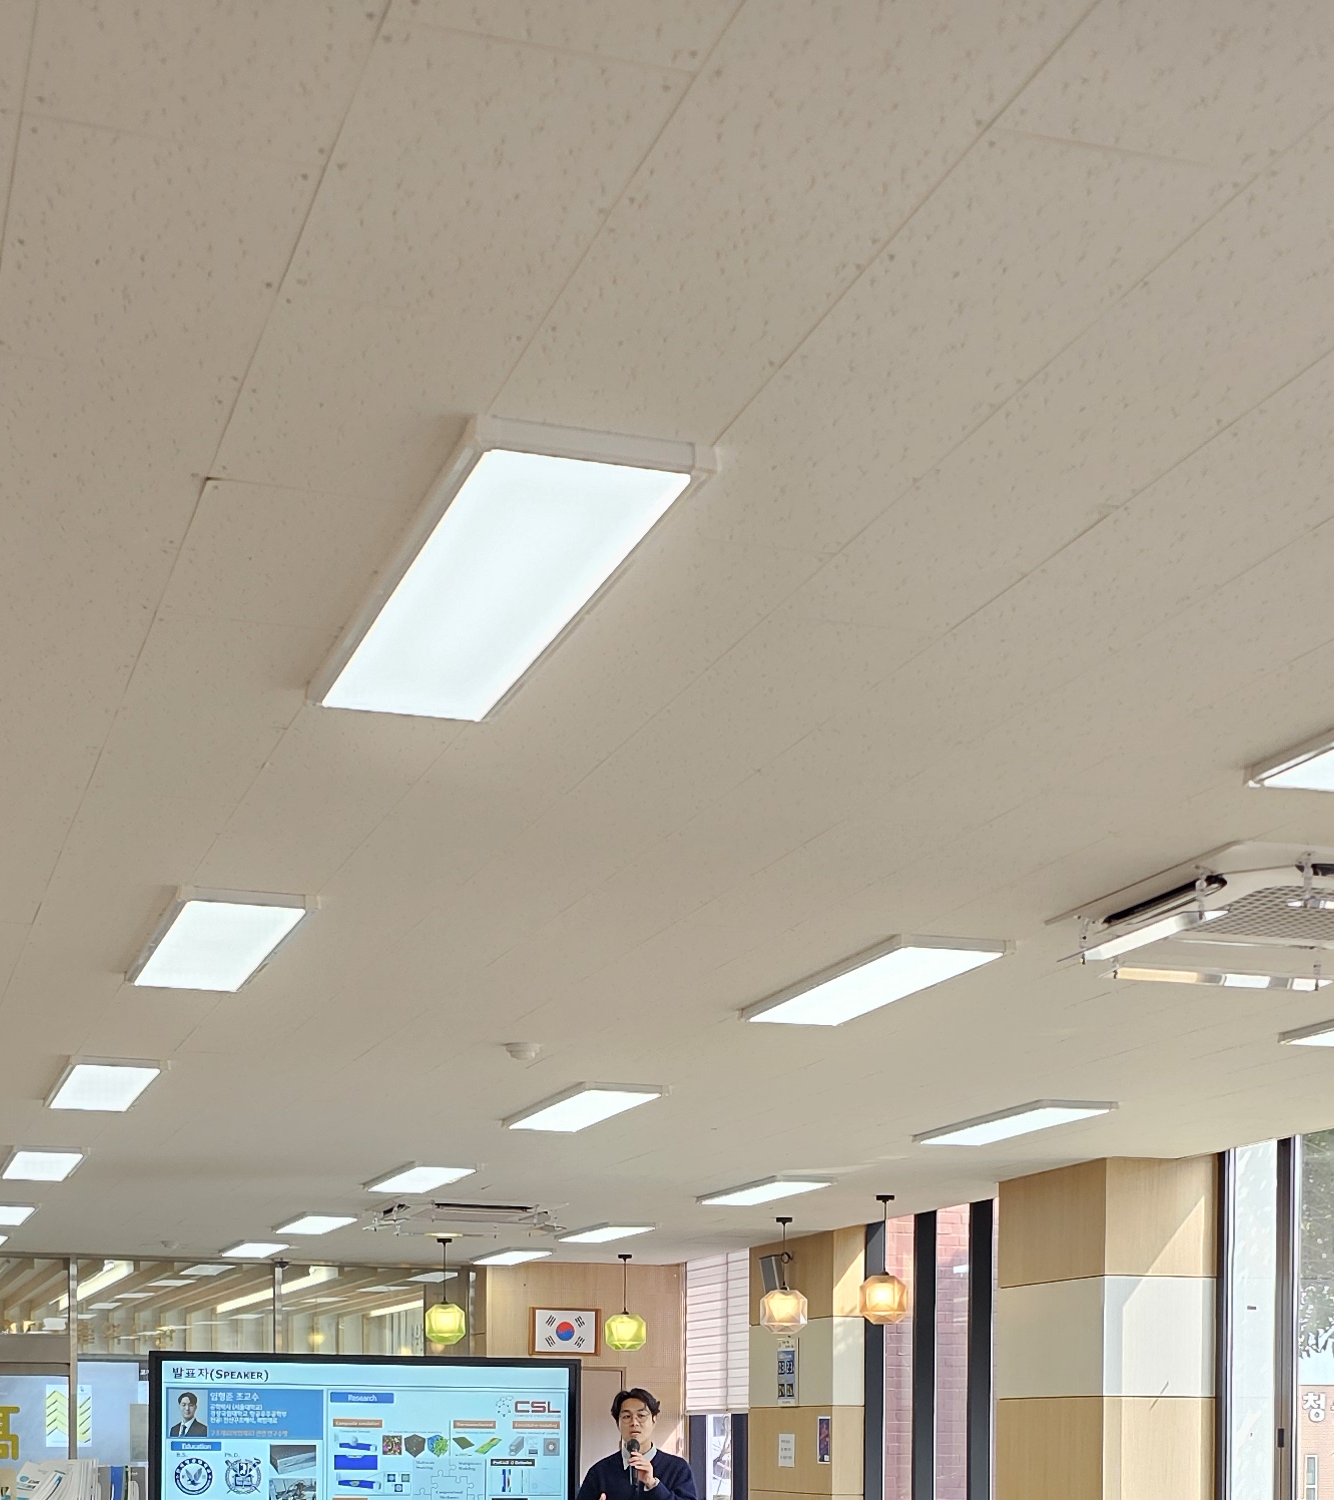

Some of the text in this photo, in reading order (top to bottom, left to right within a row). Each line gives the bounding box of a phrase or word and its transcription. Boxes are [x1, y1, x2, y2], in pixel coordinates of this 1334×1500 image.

[172, 1367, 269, 1382] 발표자(SPEAKER)
[348, 1394, 377, 1402] Research
[515, 1401, 561, 1413] CSL
